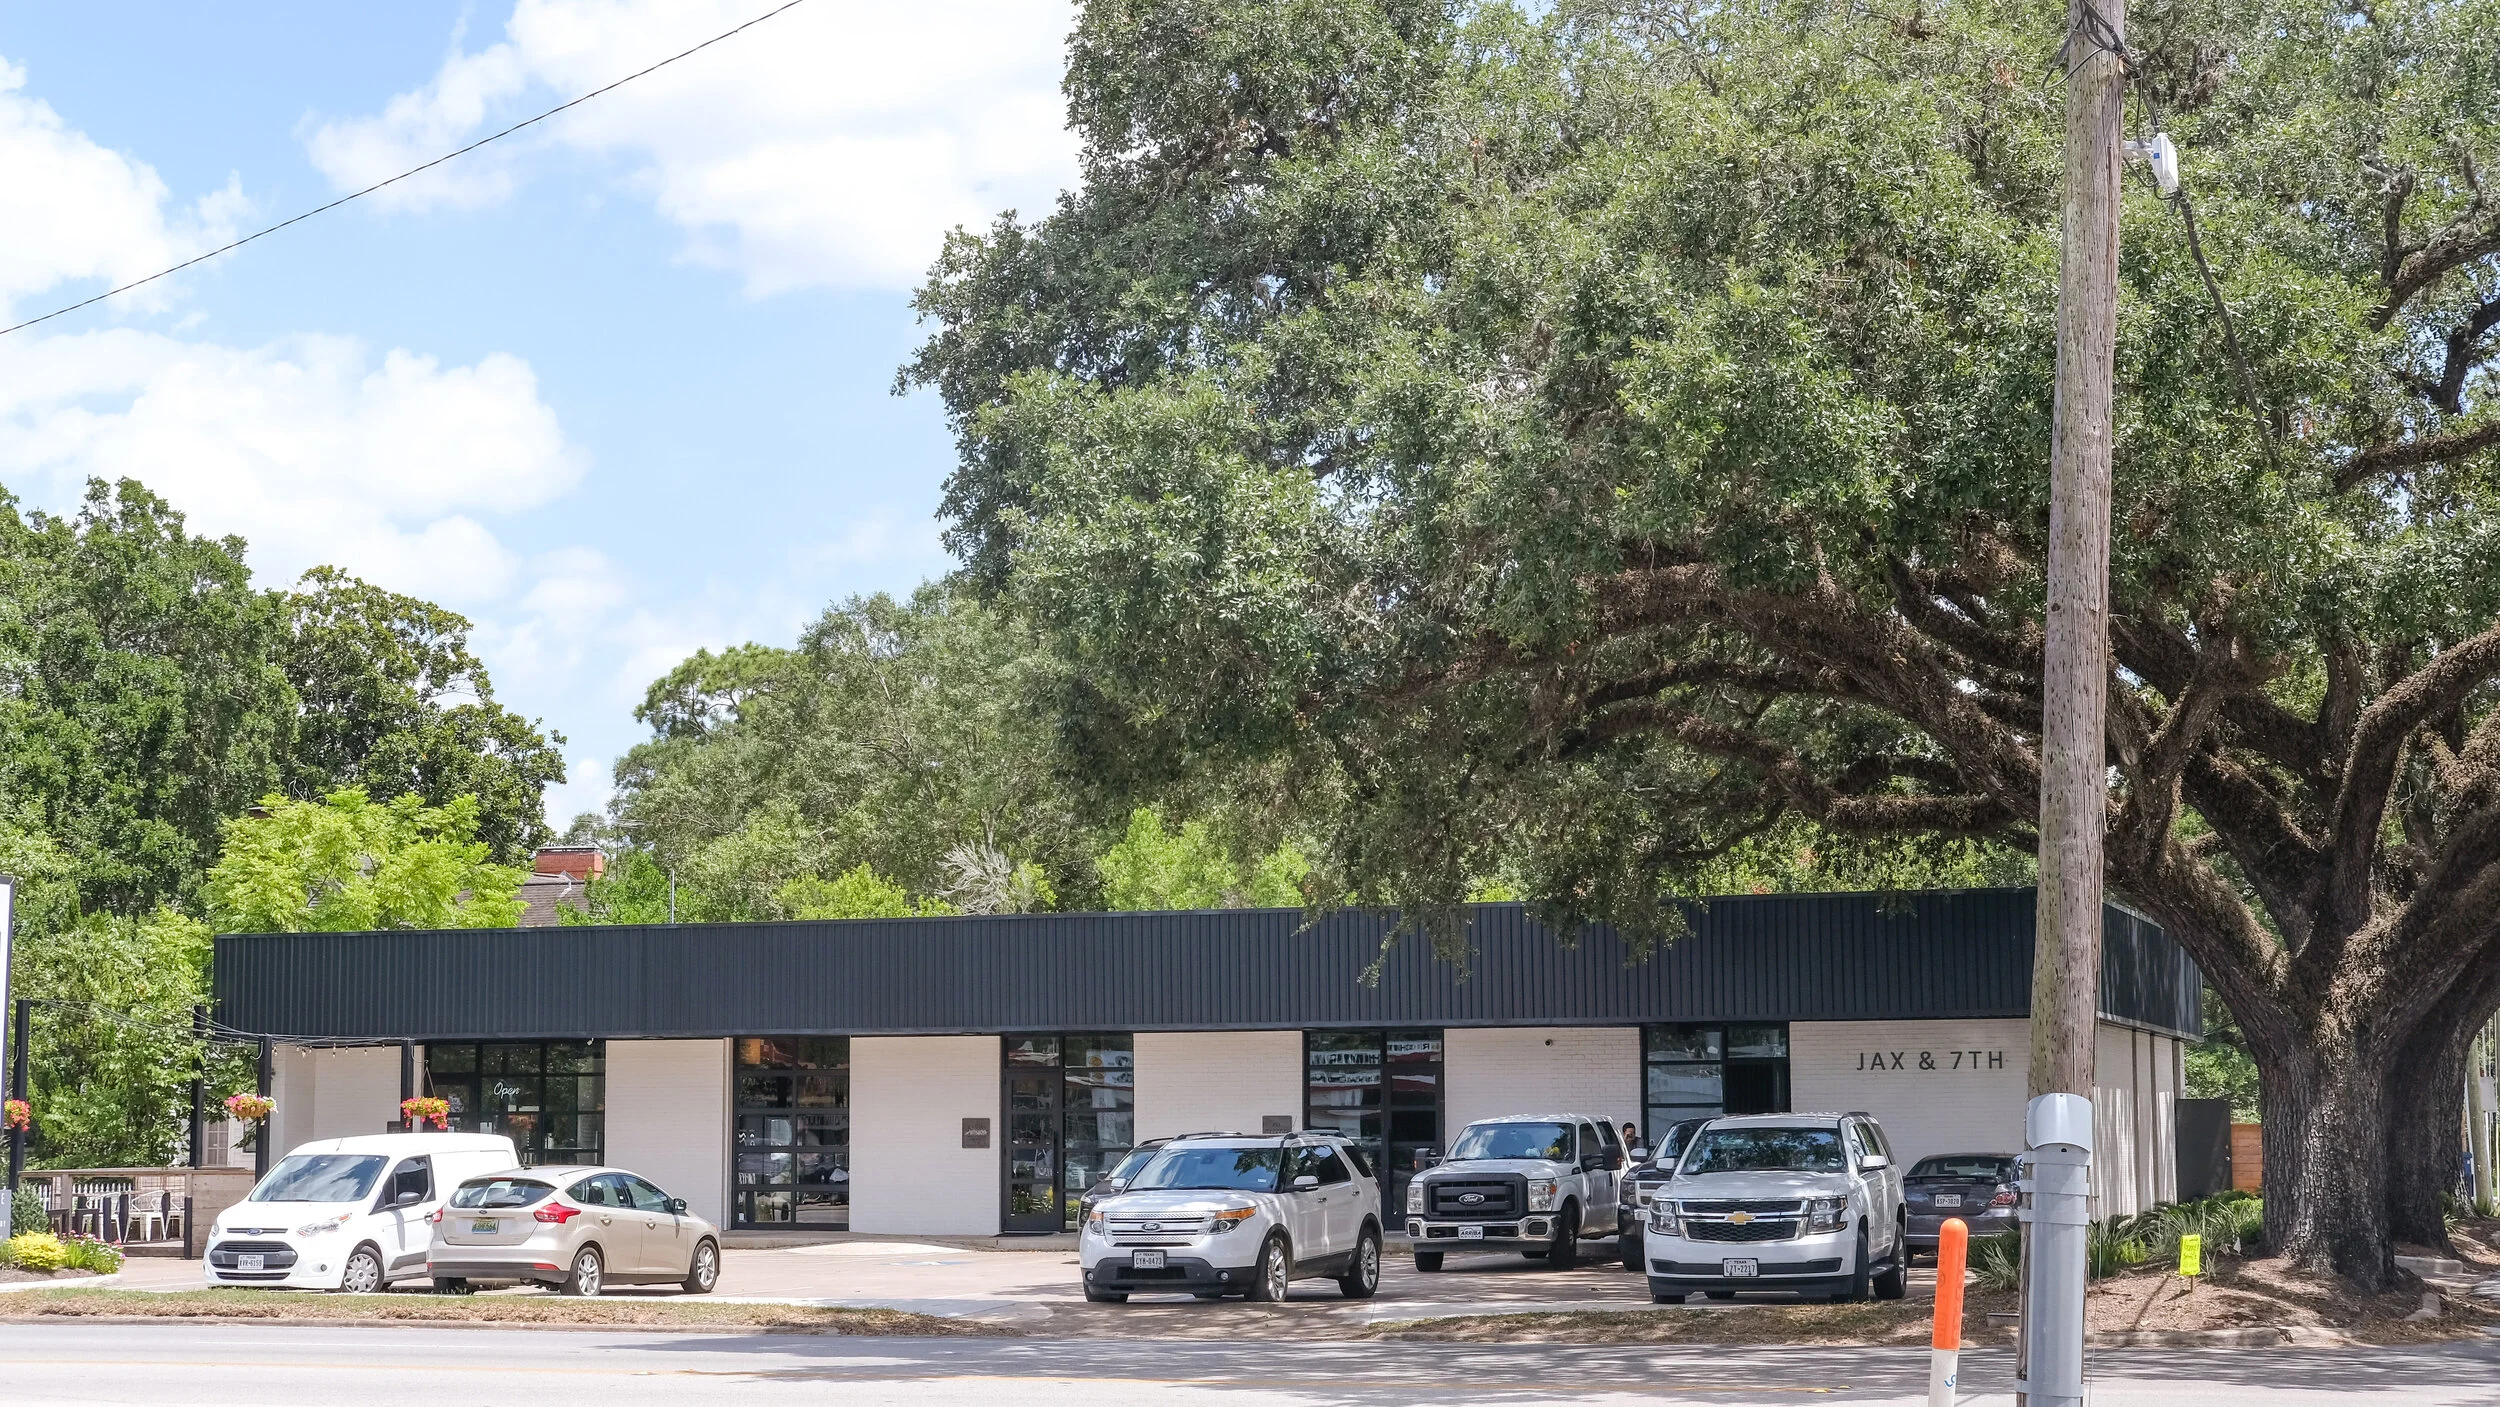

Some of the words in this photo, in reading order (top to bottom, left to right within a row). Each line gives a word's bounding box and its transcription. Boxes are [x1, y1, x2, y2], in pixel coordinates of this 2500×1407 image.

[1856, 1051, 1905, 1071] JAX
[1918, 1051, 1936, 1071] &
[1950, 1050, 2003, 1070] 7TH
[493, 1081, 521, 1100] Open
